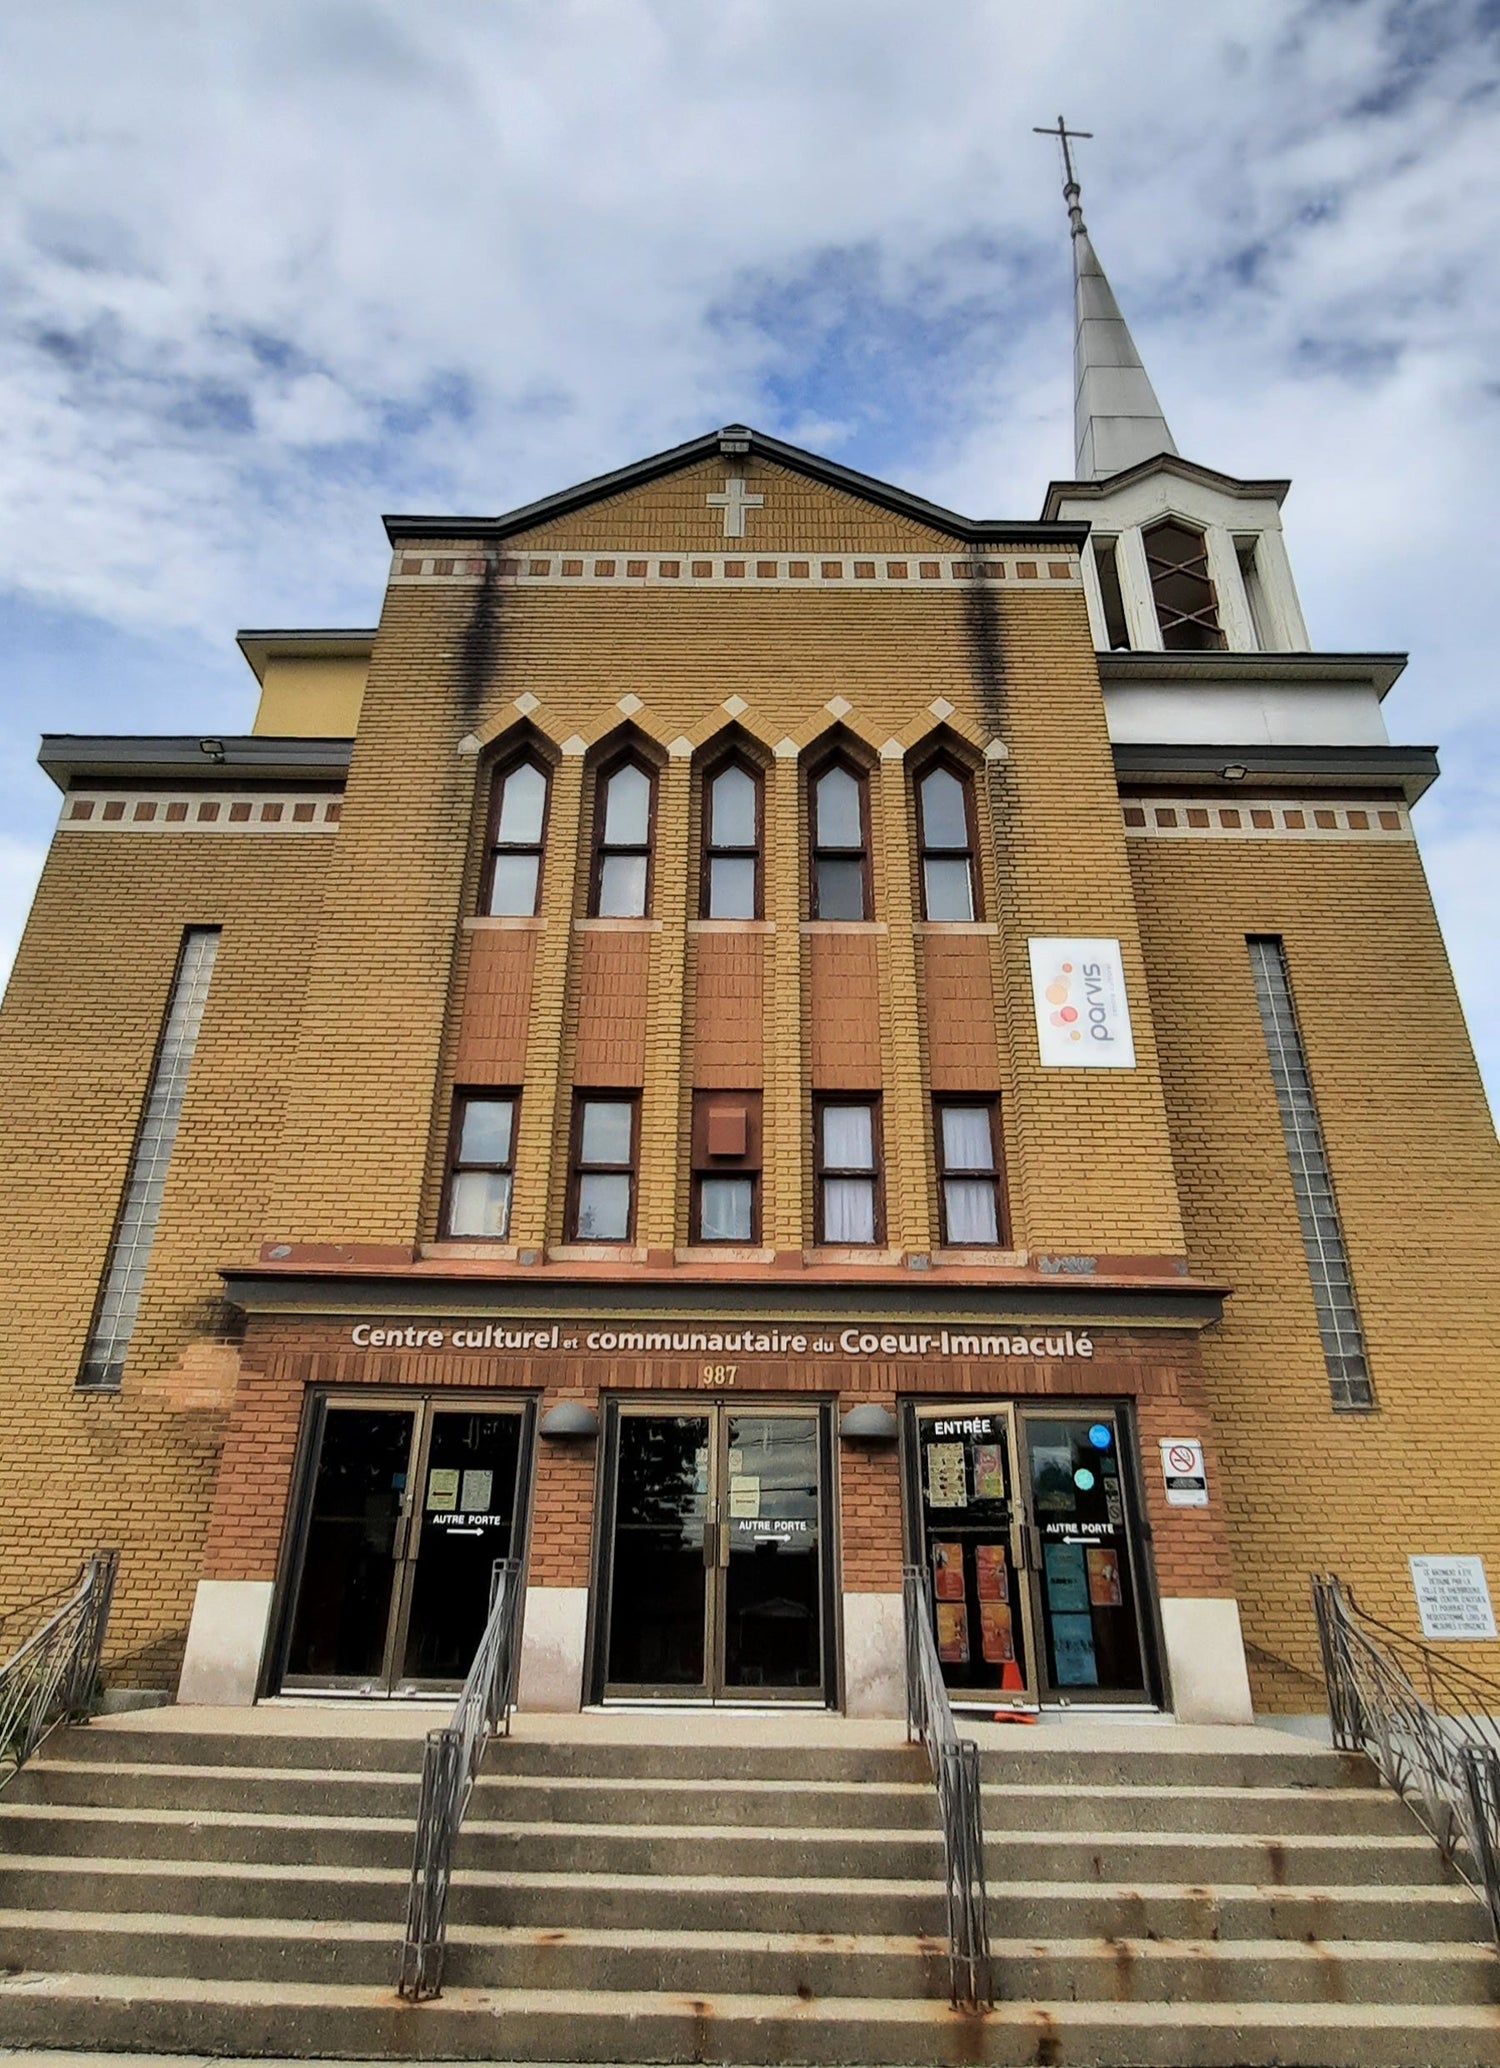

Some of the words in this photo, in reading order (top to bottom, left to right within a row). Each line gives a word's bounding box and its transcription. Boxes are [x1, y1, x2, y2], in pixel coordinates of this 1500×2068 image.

[351, 1323, 444, 1348] Centre
[451, 1326, 559, 1350] culturel
[562, 1337, 578, 1349] et
[586, 1329, 807, 1353] communautaire
[812, 1336, 835, 1353] du
[840, 1329, 1093, 1358] Coeur-Immaculé
[703, 1365, 737, 1384] 987
[935, 1417, 992, 1435] ENTRÉE
[433, 1514, 465, 1525] AUTRE
[468, 1515, 501, 1526] PORTE
[739, 1520, 770, 1531] AUTRE
[774, 1521, 807, 1531] PORTE
[1046, 1523, 1079, 1534] AUTRE
[1081, 1523, 1115, 1534] PORTE
